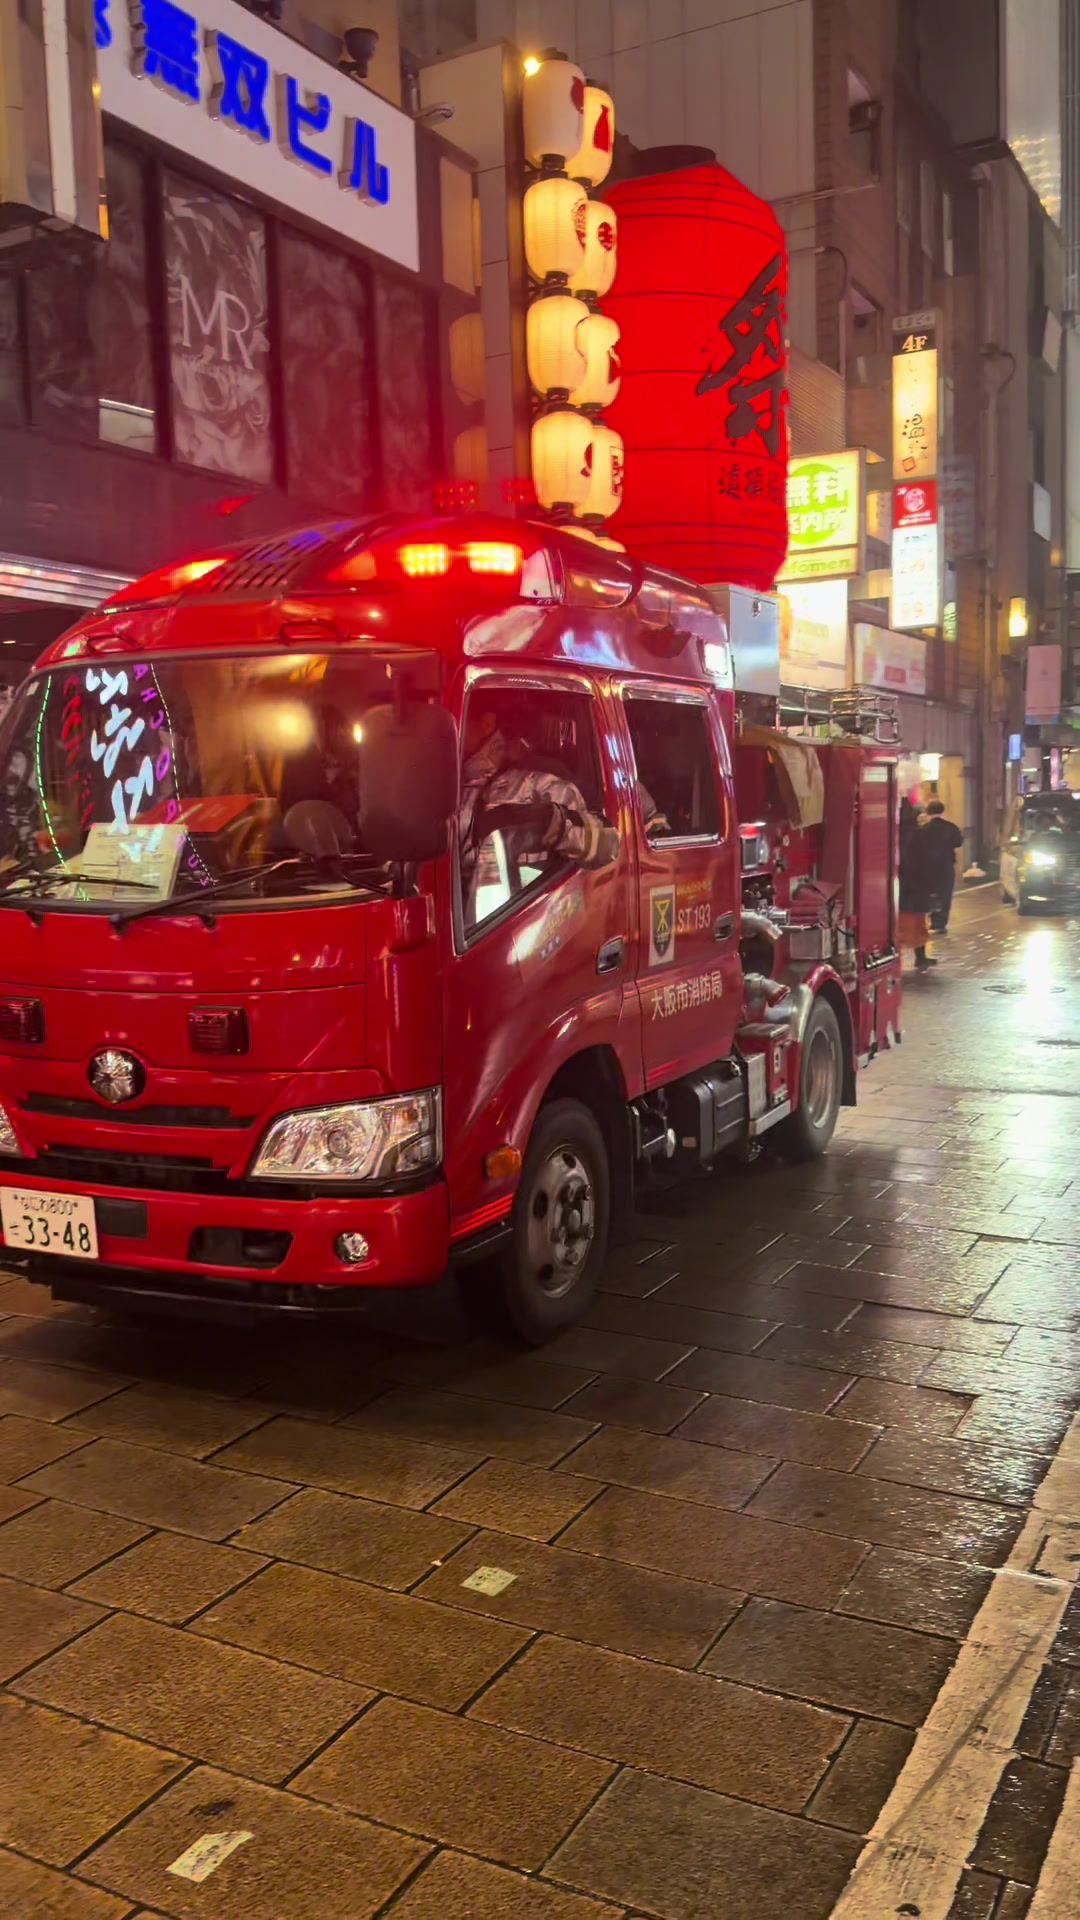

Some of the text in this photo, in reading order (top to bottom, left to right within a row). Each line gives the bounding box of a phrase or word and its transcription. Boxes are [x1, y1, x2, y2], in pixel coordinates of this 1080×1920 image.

[179, 274, 254, 370] MR
[902, 334, 928, 353] 4F
[651, 970, 723, 1021] 大阪市消防局
